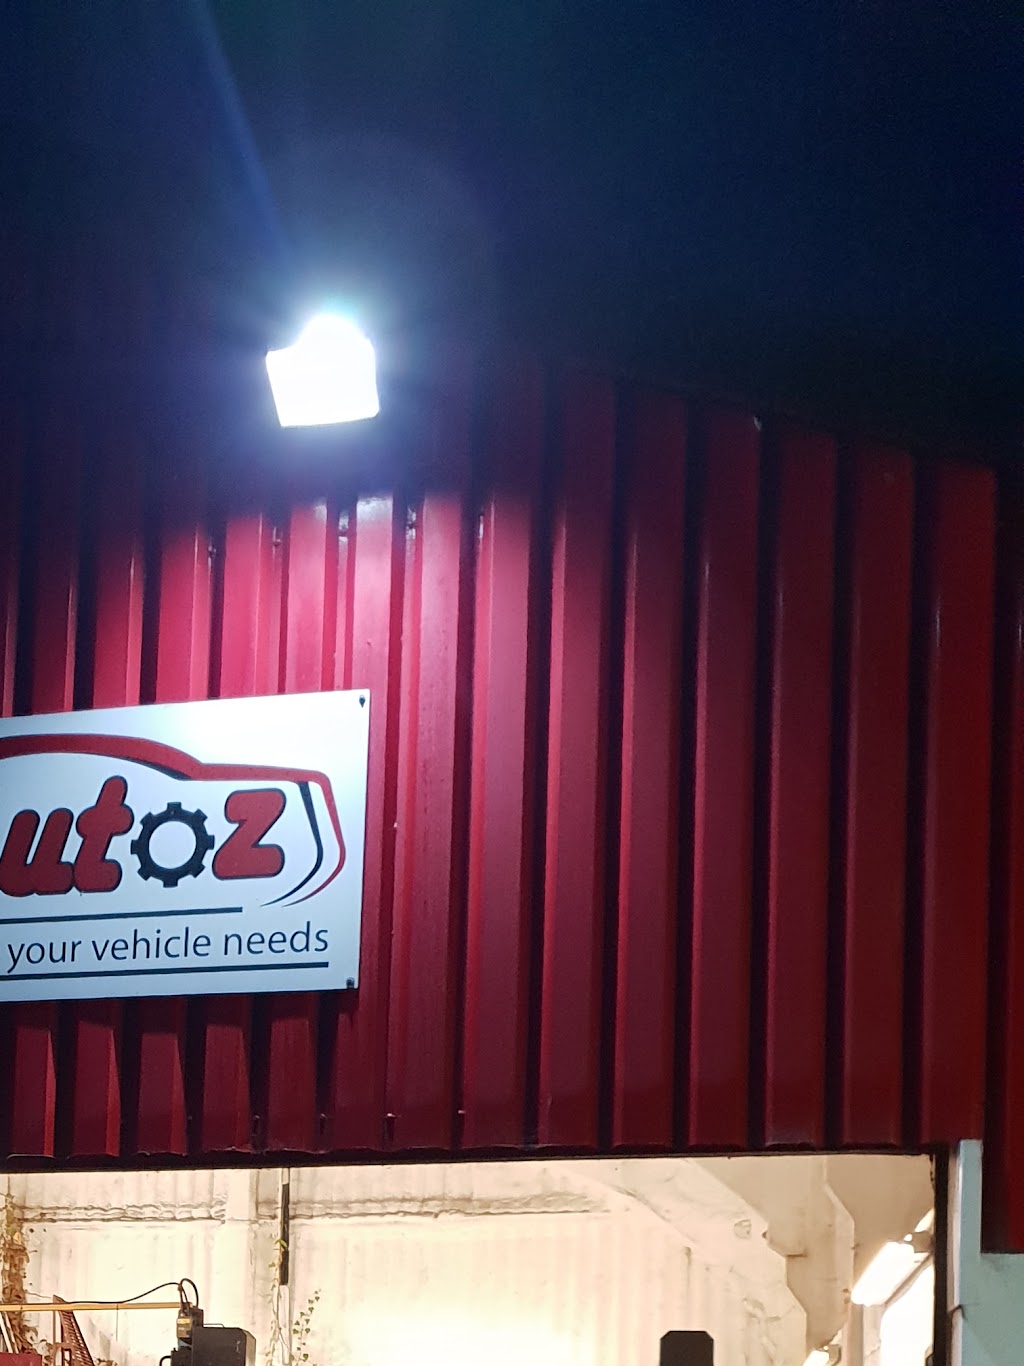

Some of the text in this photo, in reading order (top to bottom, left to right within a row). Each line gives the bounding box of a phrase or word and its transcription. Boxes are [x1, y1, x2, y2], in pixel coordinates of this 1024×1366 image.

[7, 939, 82, 974] your
[91, 926, 212, 961] vehicle
[224, 920, 329, 956] needs
